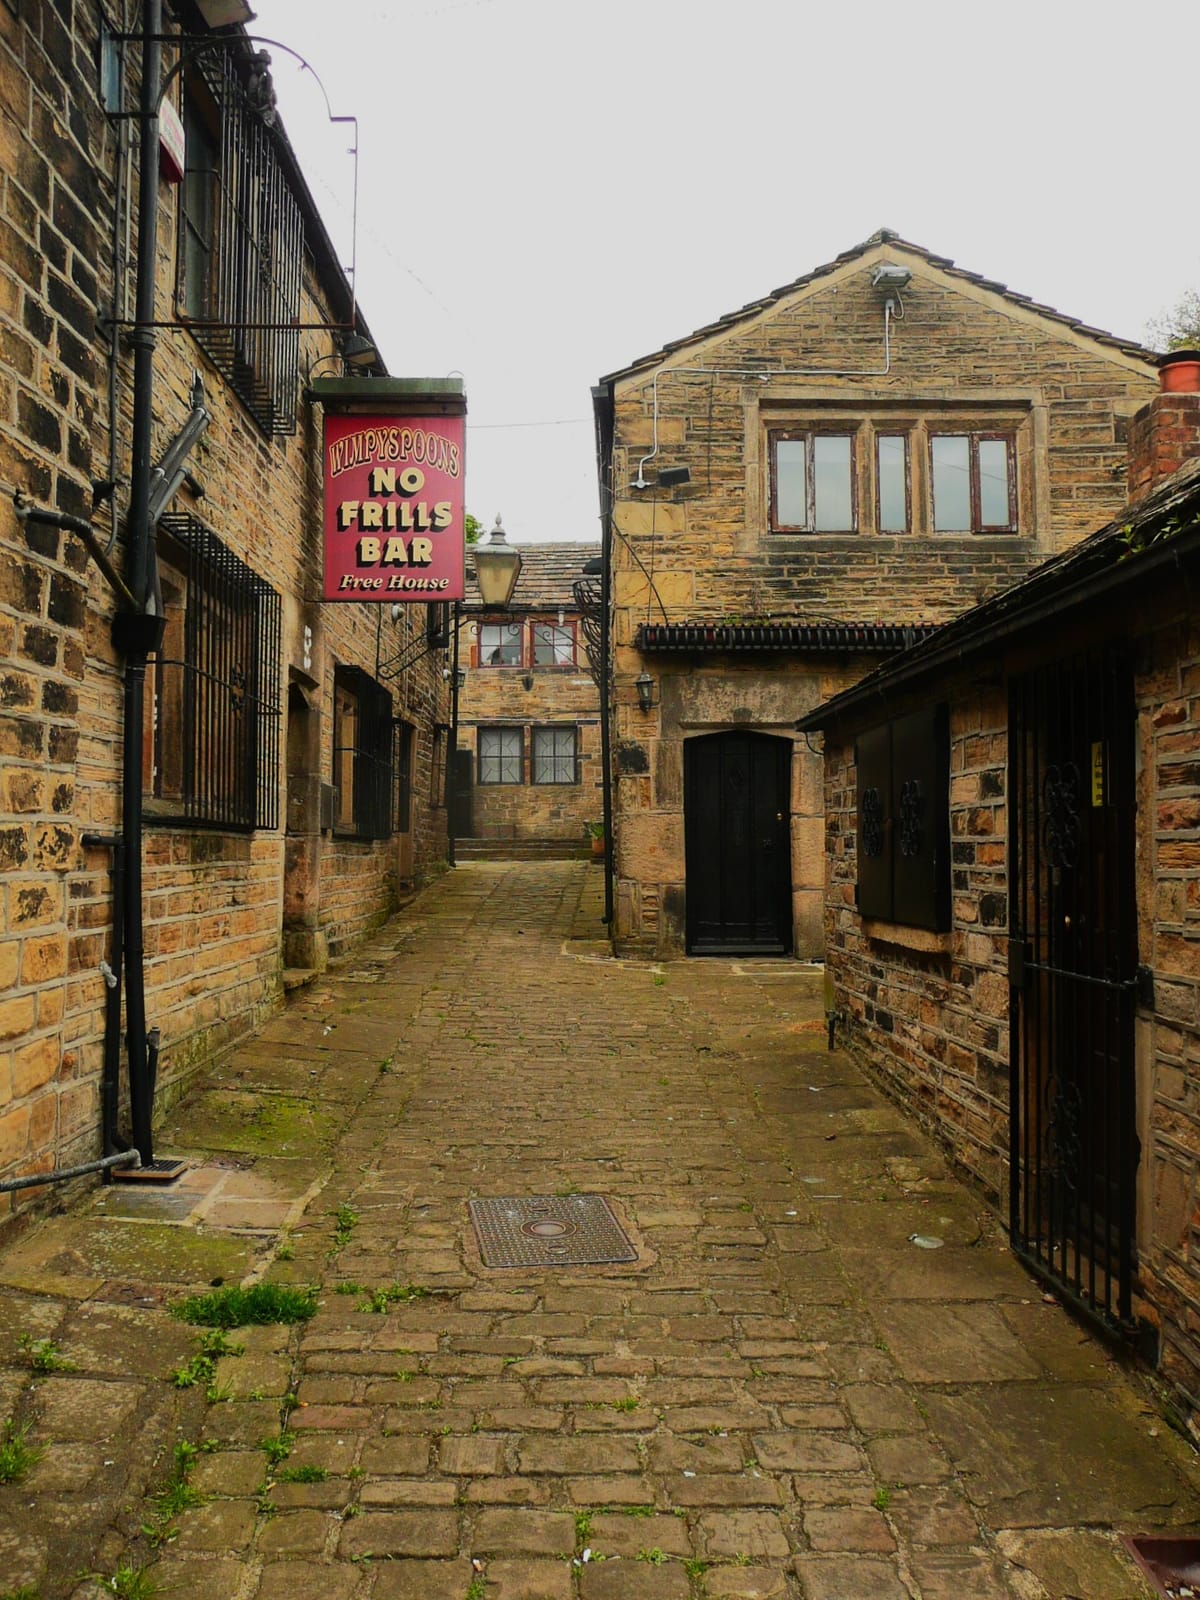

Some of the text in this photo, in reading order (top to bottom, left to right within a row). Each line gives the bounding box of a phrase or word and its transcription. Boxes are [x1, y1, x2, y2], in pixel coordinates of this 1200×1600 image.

[329, 427, 460, 478] WIMPYSPOONS
[370, 466, 425, 496] NO
[338, 501, 453, 531] FRILLS
[357, 536, 433, 566] BAR
[339, 574, 450, 590] Free House
